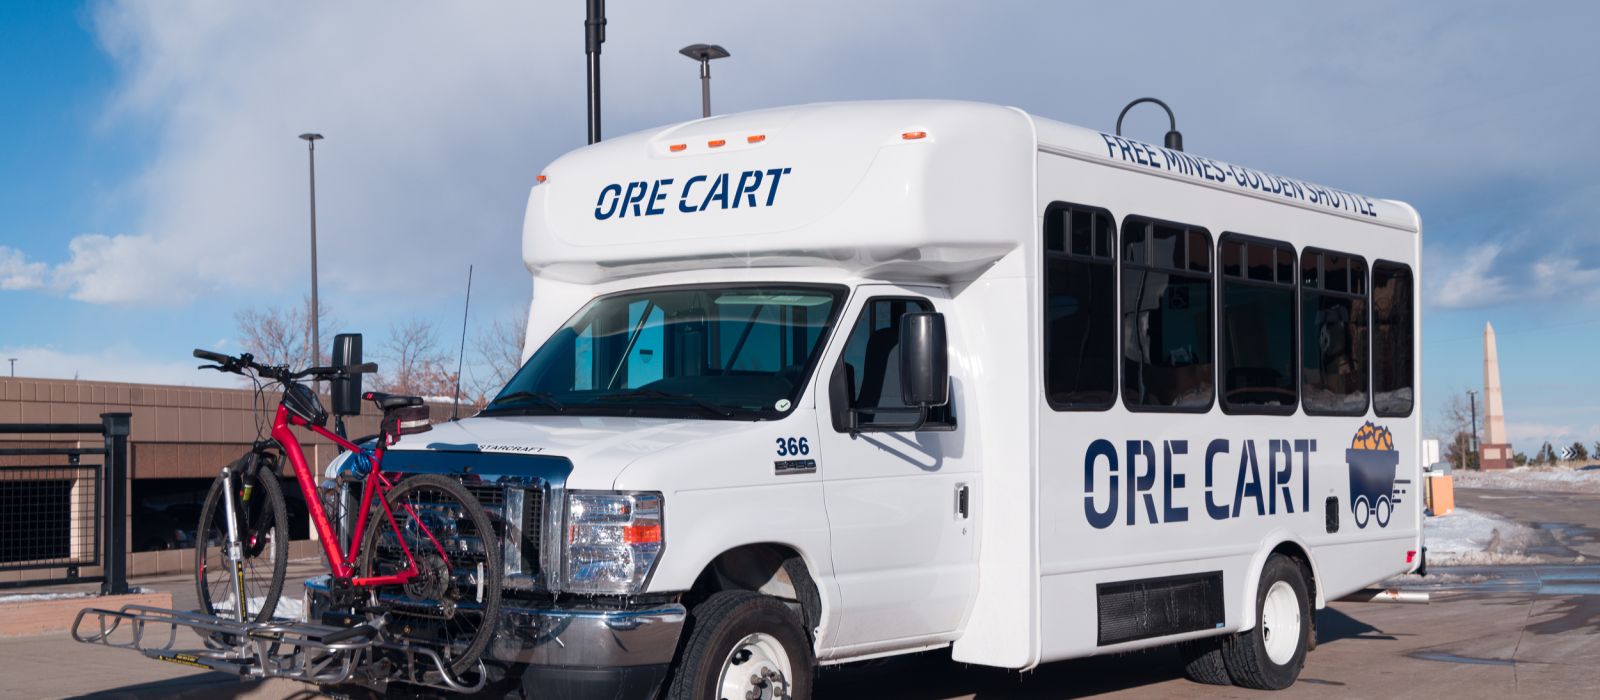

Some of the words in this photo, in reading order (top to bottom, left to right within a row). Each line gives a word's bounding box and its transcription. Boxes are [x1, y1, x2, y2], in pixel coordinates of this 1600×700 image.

[594, 178, 674, 221] ORE
[678, 167, 792, 213] CART
[1099, 132, 1161, 169] FREE
[1303, 181, 1378, 217] SHUTTLE
[479, 443, 546, 453] STARCRAFT
[776, 436, 810, 456] 366
[1083, 438, 1189, 529] ORE
[1204, 438, 1317, 520] CART
